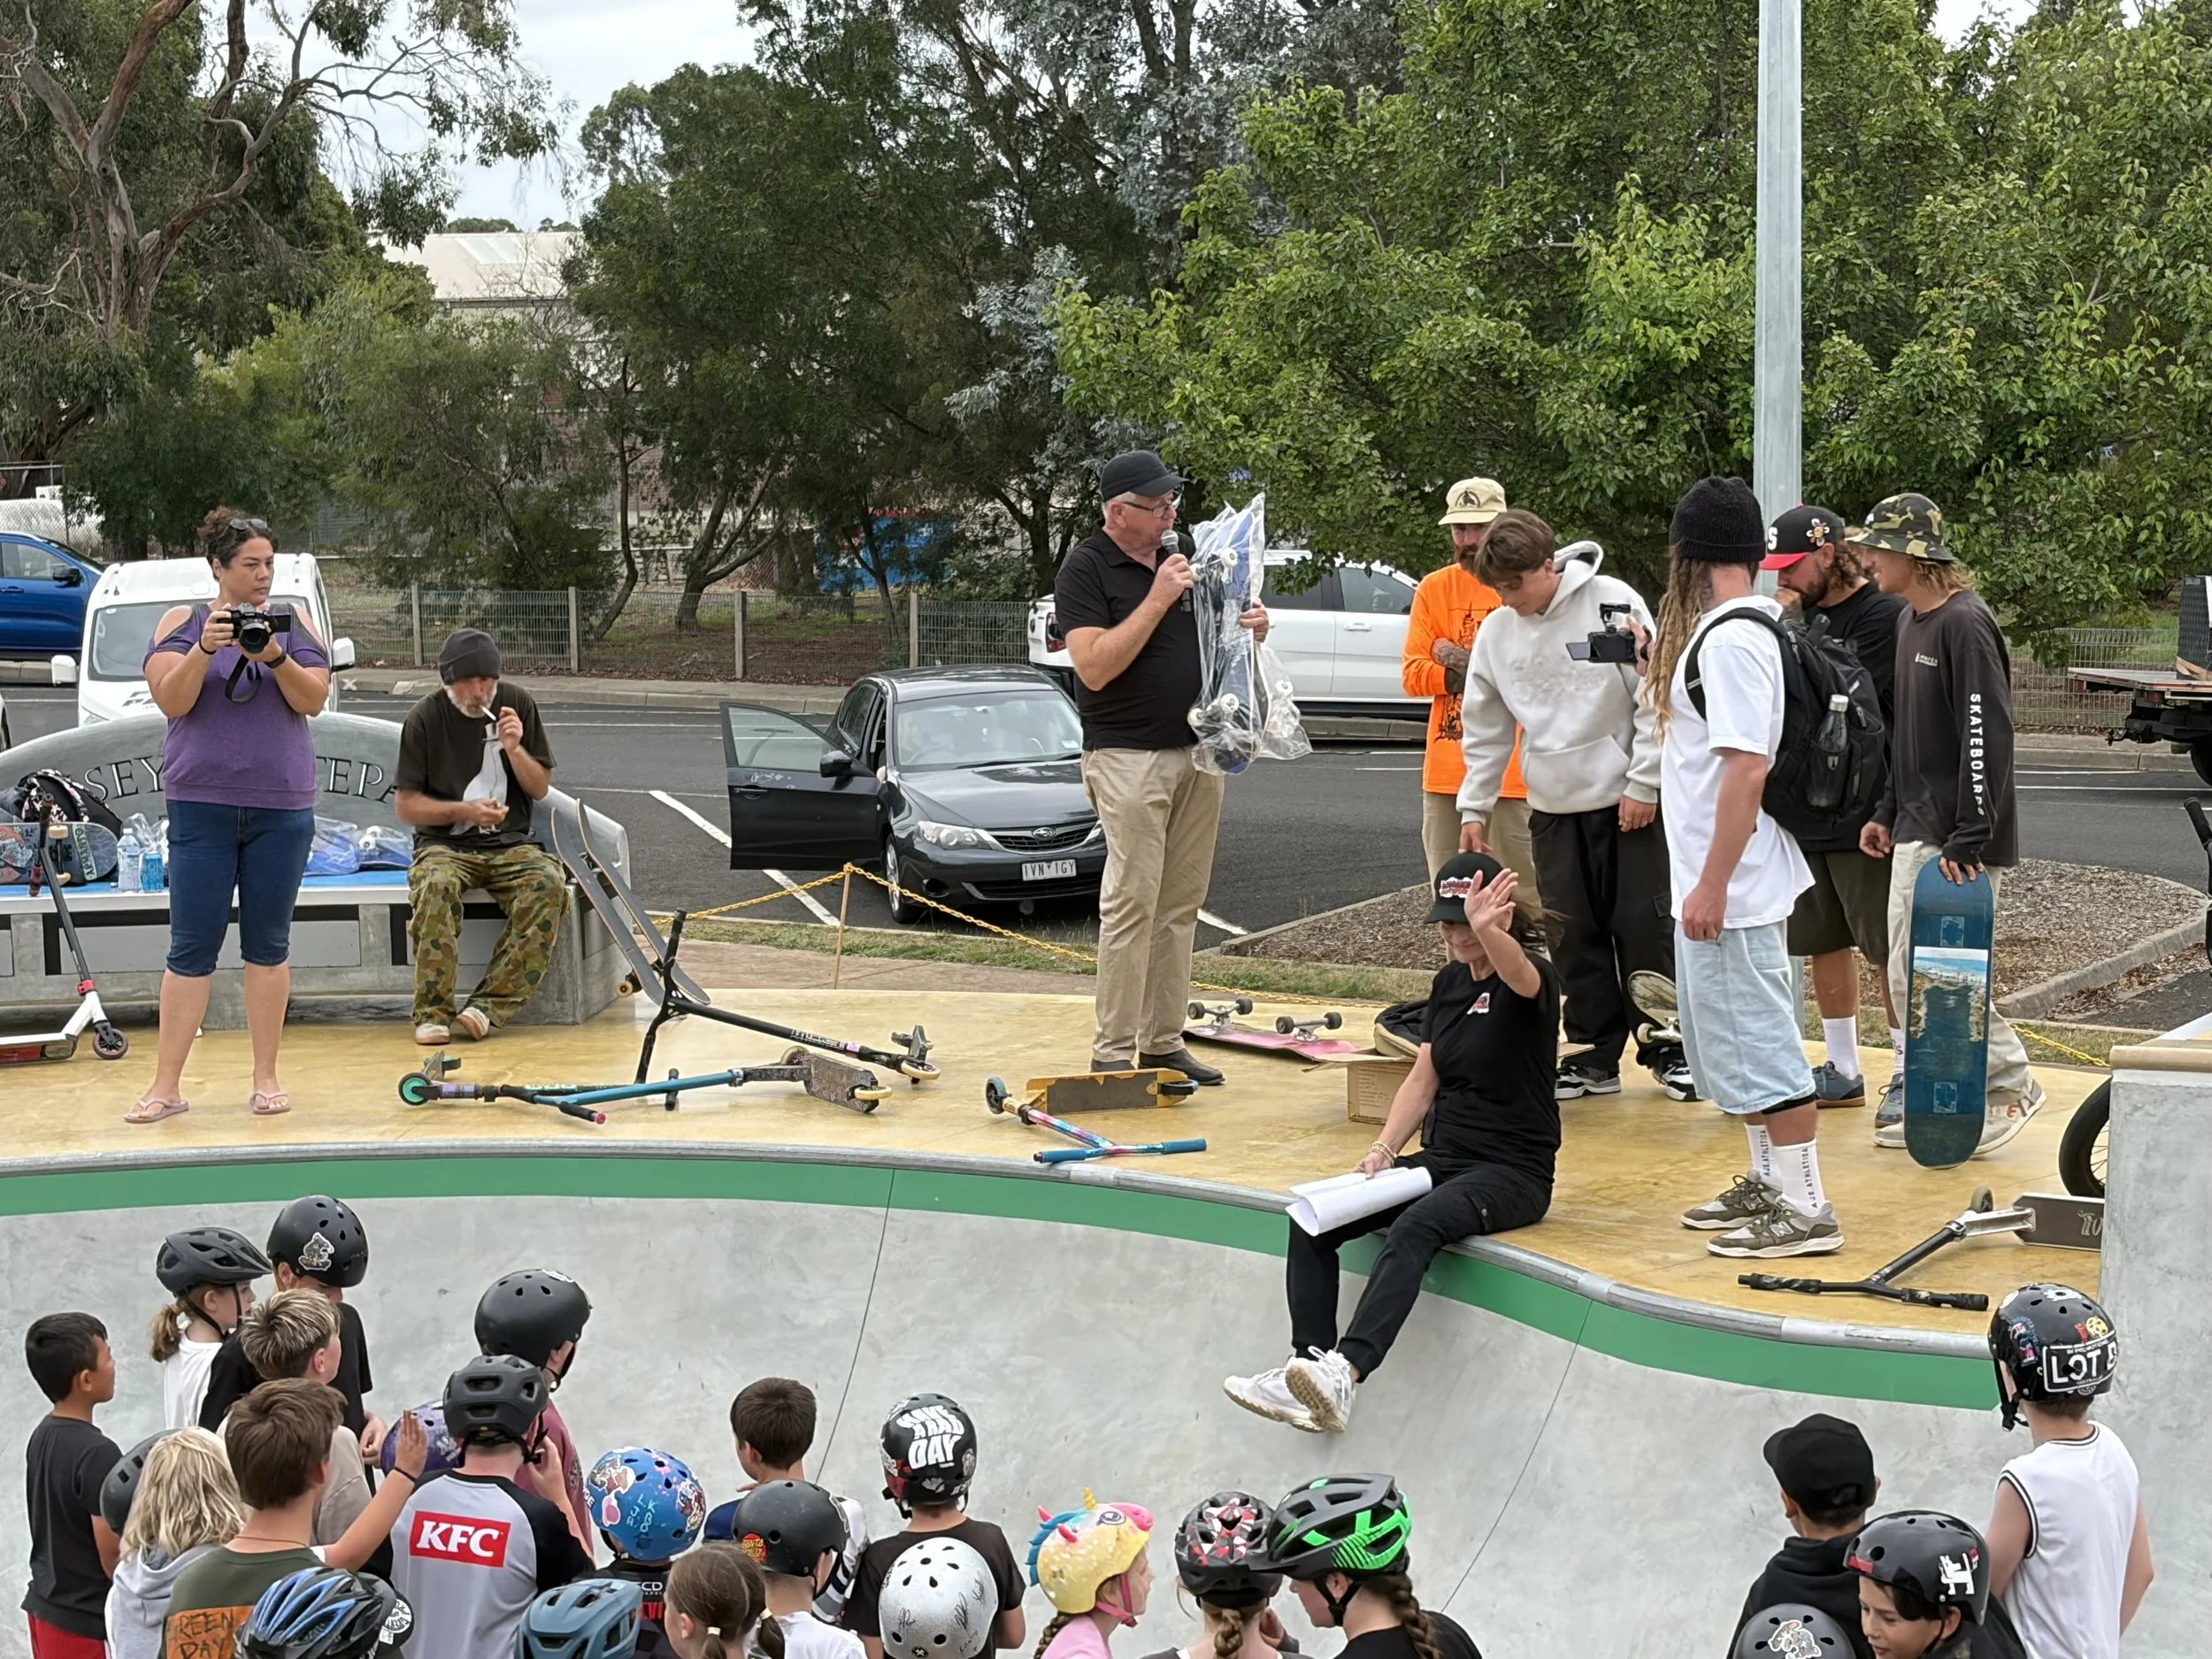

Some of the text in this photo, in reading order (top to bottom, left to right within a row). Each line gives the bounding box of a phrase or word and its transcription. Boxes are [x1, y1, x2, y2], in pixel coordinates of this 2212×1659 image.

[83, 754, 398, 804] SEY EP
[74, 826, 96, 879] ARMANTO
[1801, 1148, 1813, 1187] ATHLETICA
[2051, 1348, 2102, 1384] LOT
[895, 1404, 957, 1429] HAVE
[924, 1417, 965, 1437] RAD
[908, 1433, 963, 1470] DAY
[416, 1519, 500, 1557] KFC
